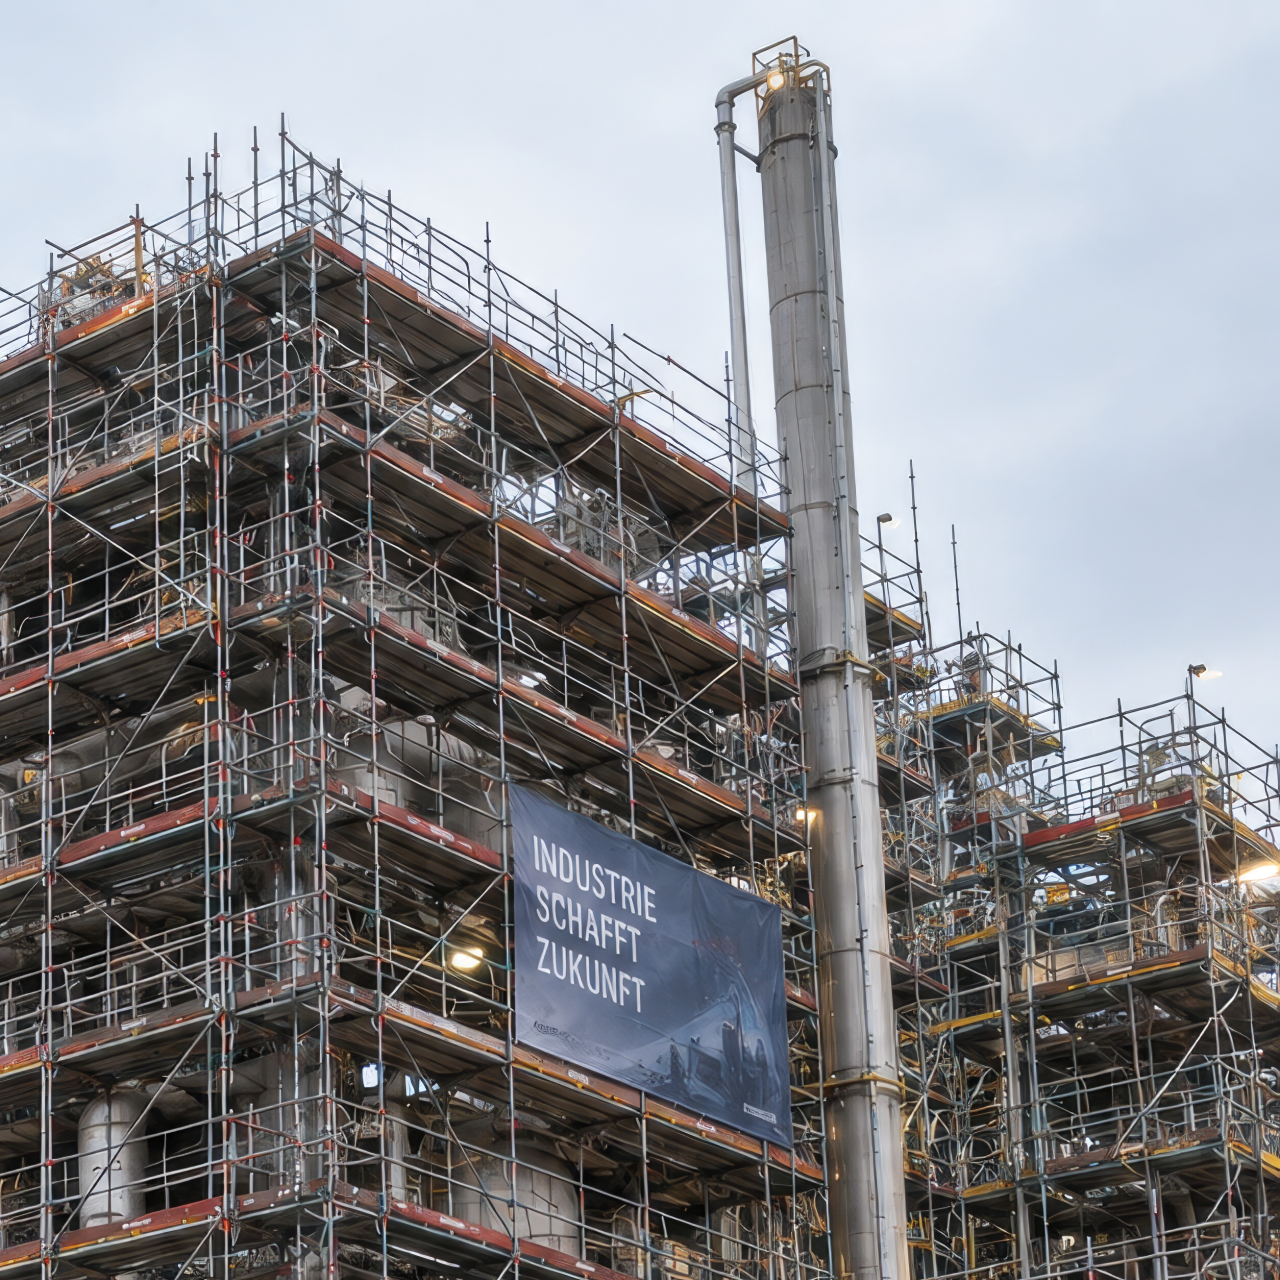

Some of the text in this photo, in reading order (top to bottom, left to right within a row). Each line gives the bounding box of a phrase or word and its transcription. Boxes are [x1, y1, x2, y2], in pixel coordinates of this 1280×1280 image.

[532, 834, 657, 924] INDUSTRIE
[535, 884, 642, 964] SCHAFFT
[536, 935, 646, 1013] ZUKUNFT
